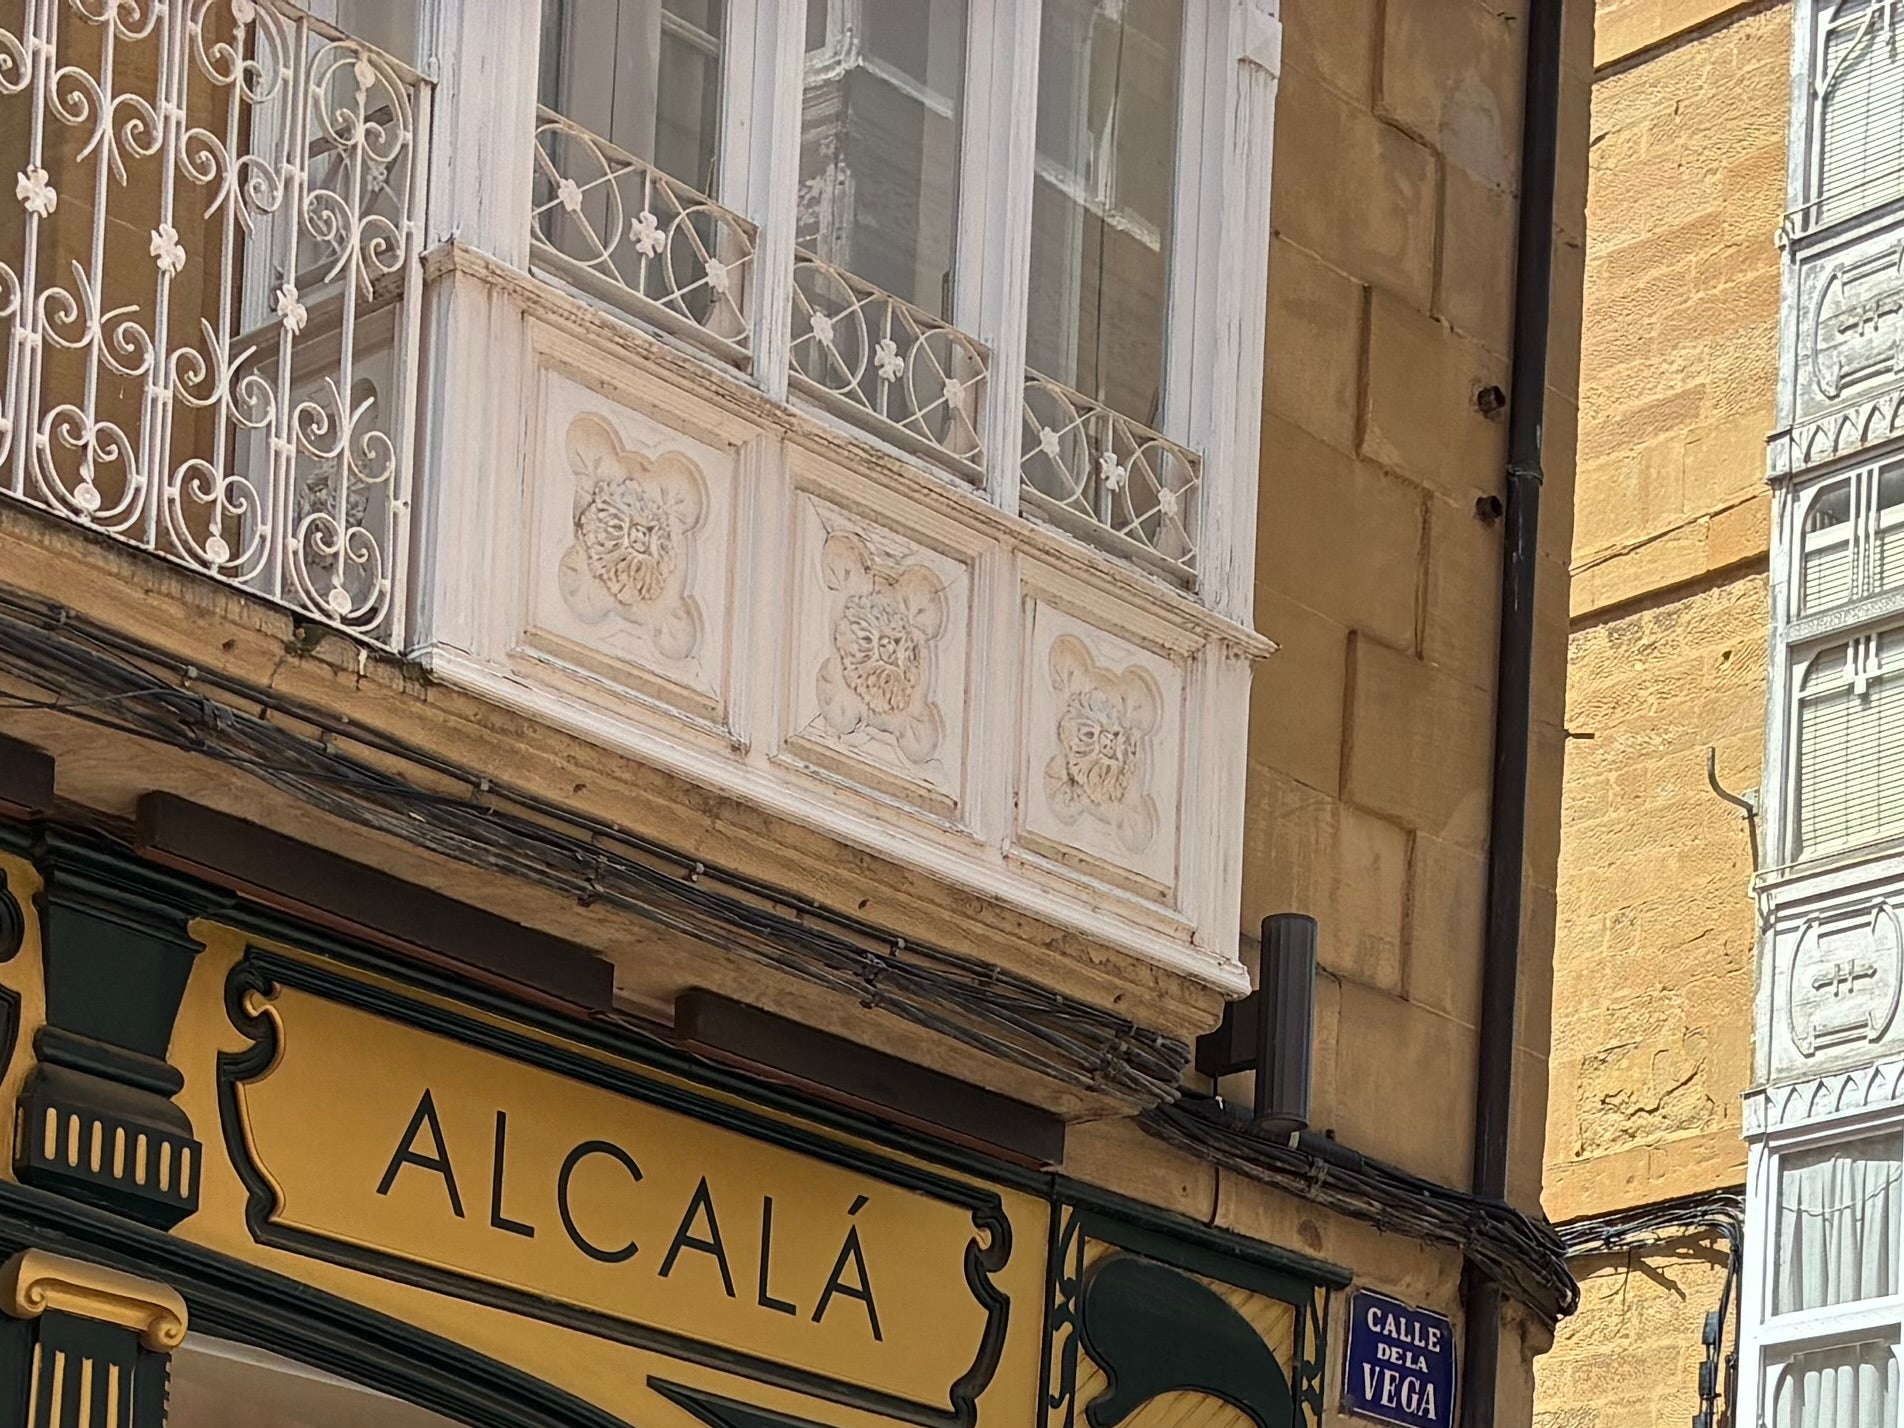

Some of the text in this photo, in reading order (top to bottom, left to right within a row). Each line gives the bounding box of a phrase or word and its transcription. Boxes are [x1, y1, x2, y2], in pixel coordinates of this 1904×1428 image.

[376, 1088, 884, 1344] ALCALÁ
[1367, 1307, 1441, 1353] CALLE
[1377, 1343, 1429, 1373] DE LA
[1362, 1362, 1437, 1420] VEGA
